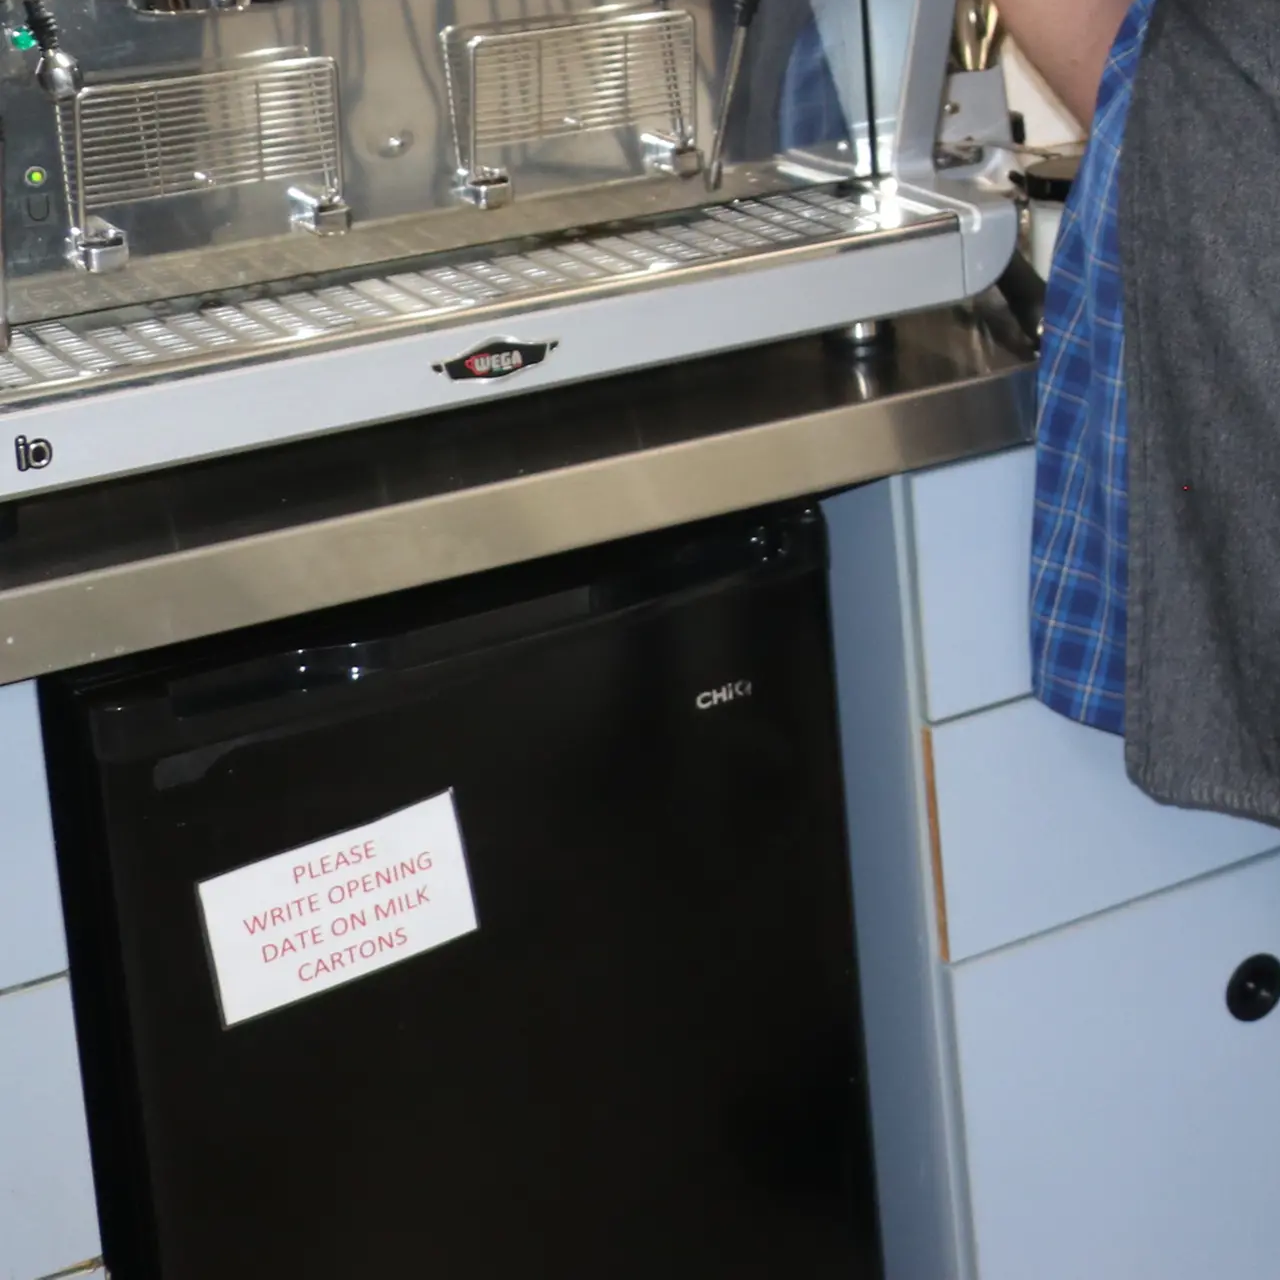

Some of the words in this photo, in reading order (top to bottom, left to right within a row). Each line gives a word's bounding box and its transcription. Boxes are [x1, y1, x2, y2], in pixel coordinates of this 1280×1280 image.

[473, 349, 523, 373] WEGA
[14, 434, 53, 472] io
[291, 839, 377, 885] PLEASE
[242, 892, 321, 936] WRITE
[327, 850, 433, 905] OPENING
[261, 925, 325, 963] DATE
[330, 910, 368, 937] ON
[374, 885, 431, 922] MILK
[297, 927, 409, 982] CARTONS
